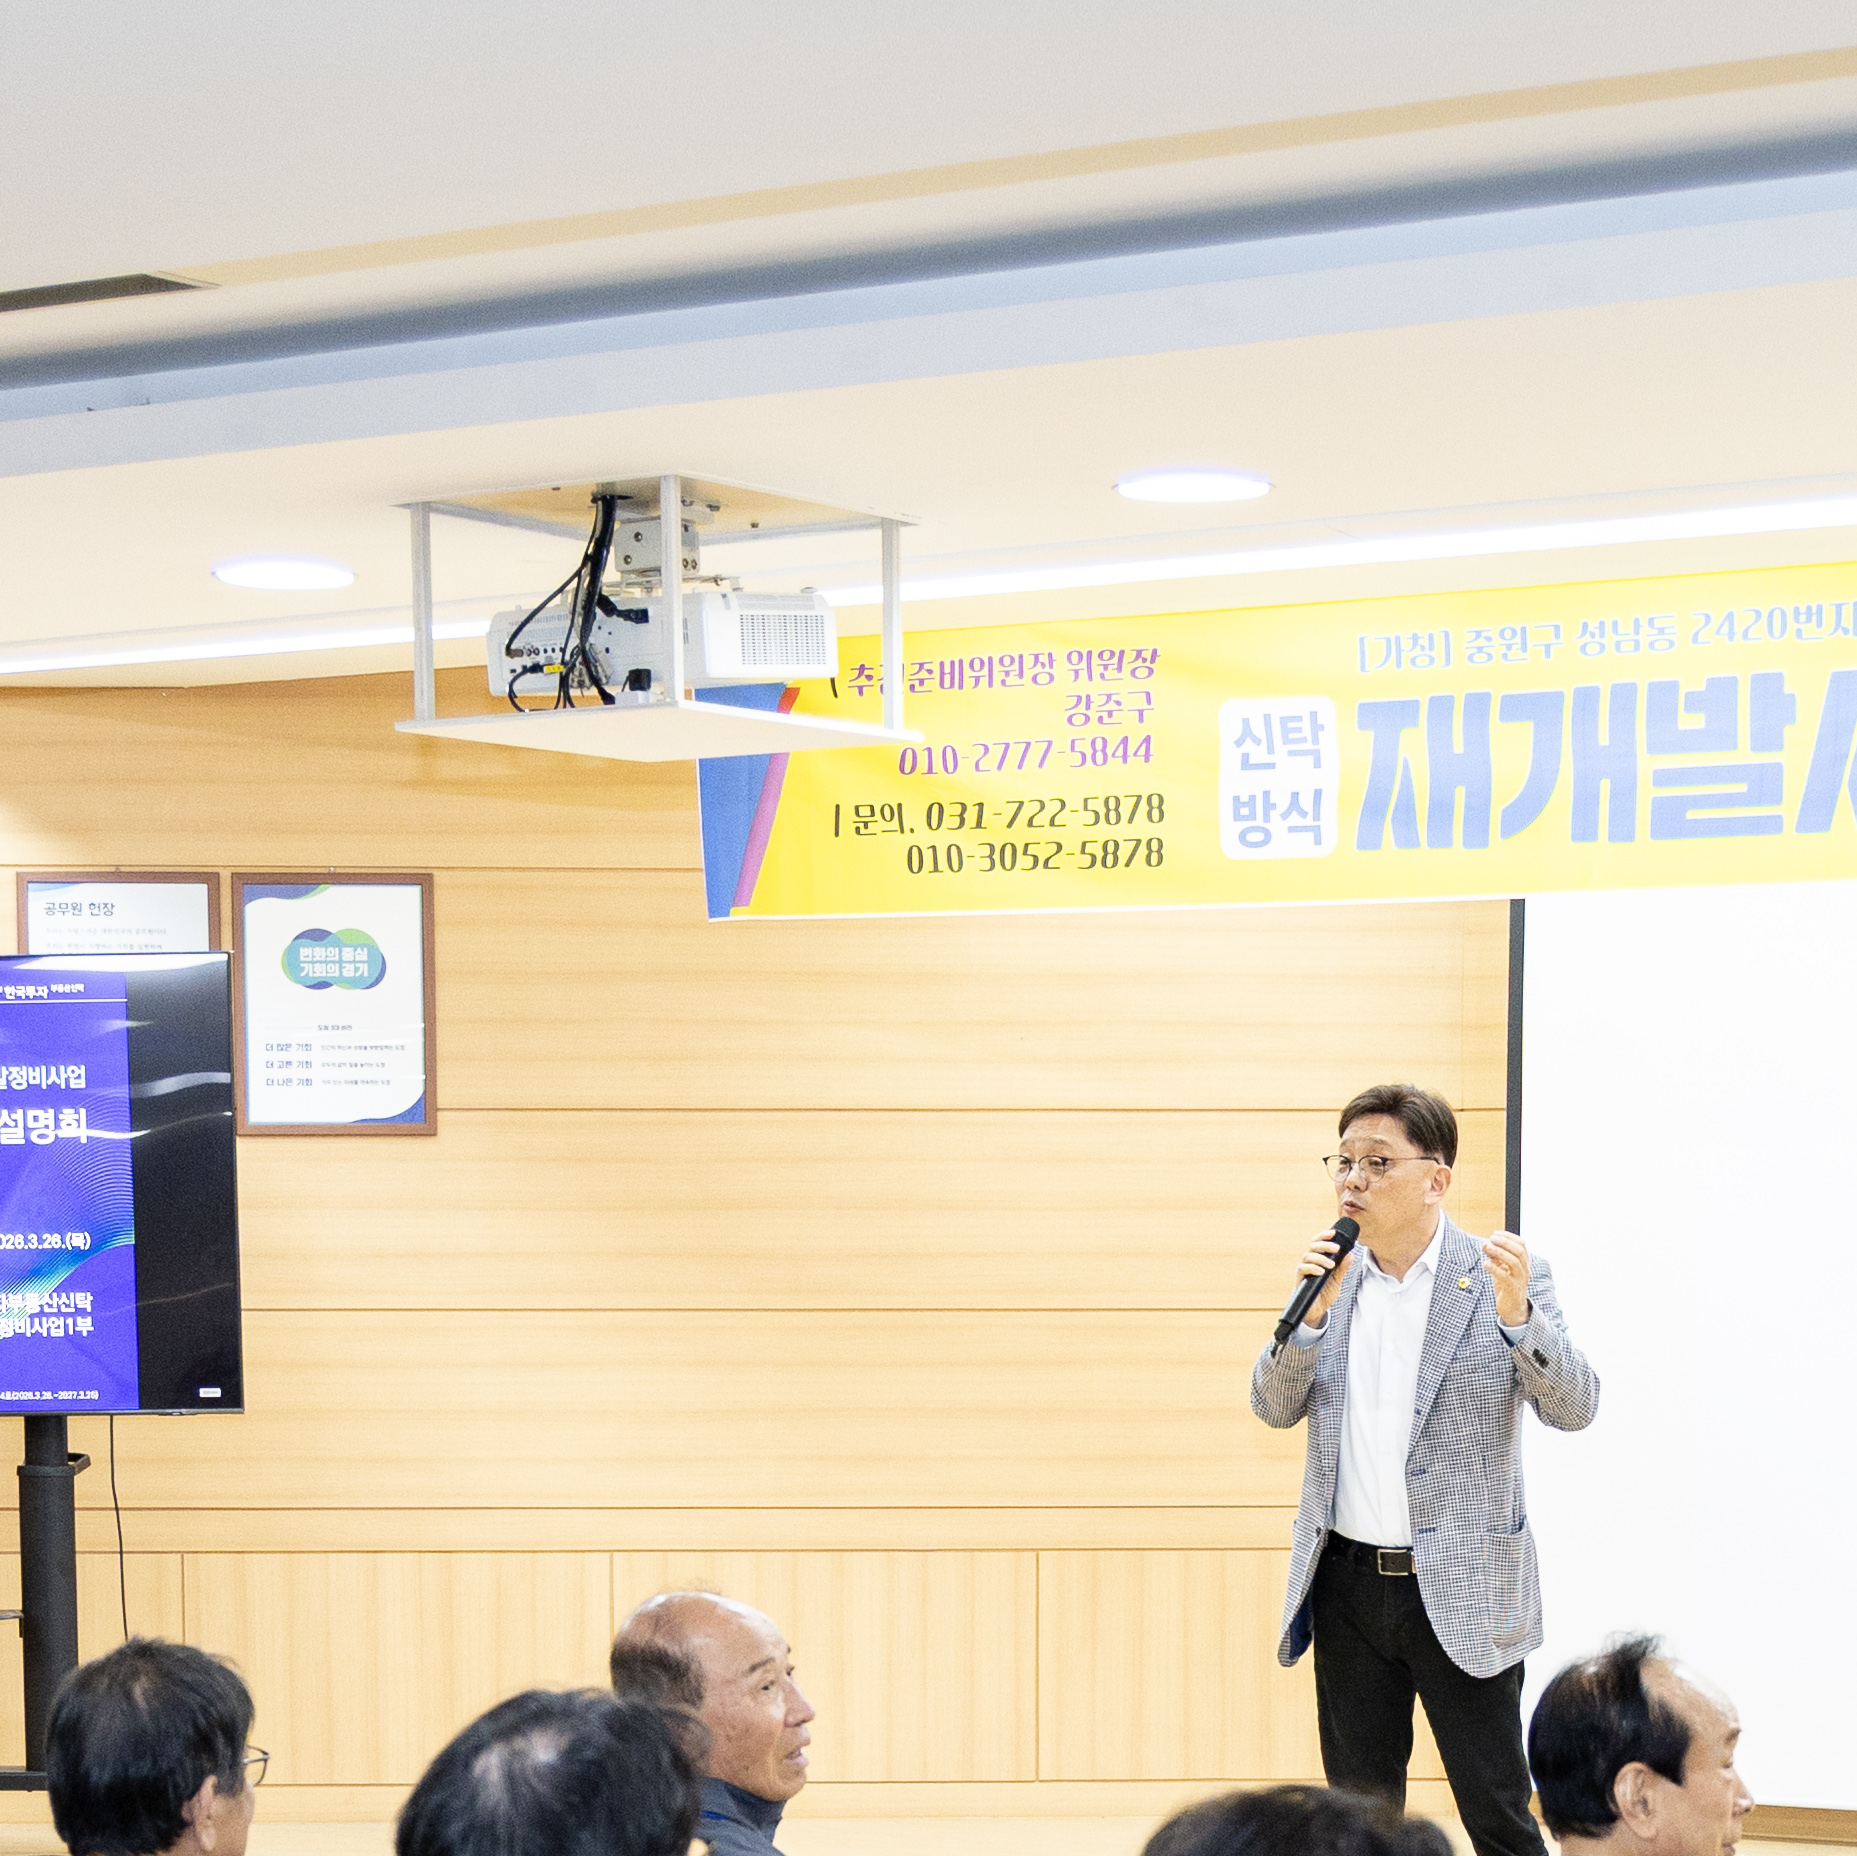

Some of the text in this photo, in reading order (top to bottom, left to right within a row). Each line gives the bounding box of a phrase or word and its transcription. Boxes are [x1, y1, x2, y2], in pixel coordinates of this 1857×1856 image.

[1357, 629, 1451, 673] [가칭]
[1463, 623, 1564, 666] 중원구
[1574, 614, 1679, 657] 성남동
[1066, 648, 1161, 684] 위원장
[1064, 690, 1155, 727] 강준구
[898, 734, 1155, 775] 010-2777-5844
[1232, 708, 1325, 772] 신탁
[925, 793, 1166, 831] 031-722-5878
[1231, 787, 1325, 849] 방식
[906, 837, 1165, 874] 010-3052-5878
[44, 902, 115, 917] 공무원 헌장
[299, 947, 340, 962] 변화의
[299, 962, 340, 978] 기회의
[0, 1315, 95, 1339] 정비사업1부
